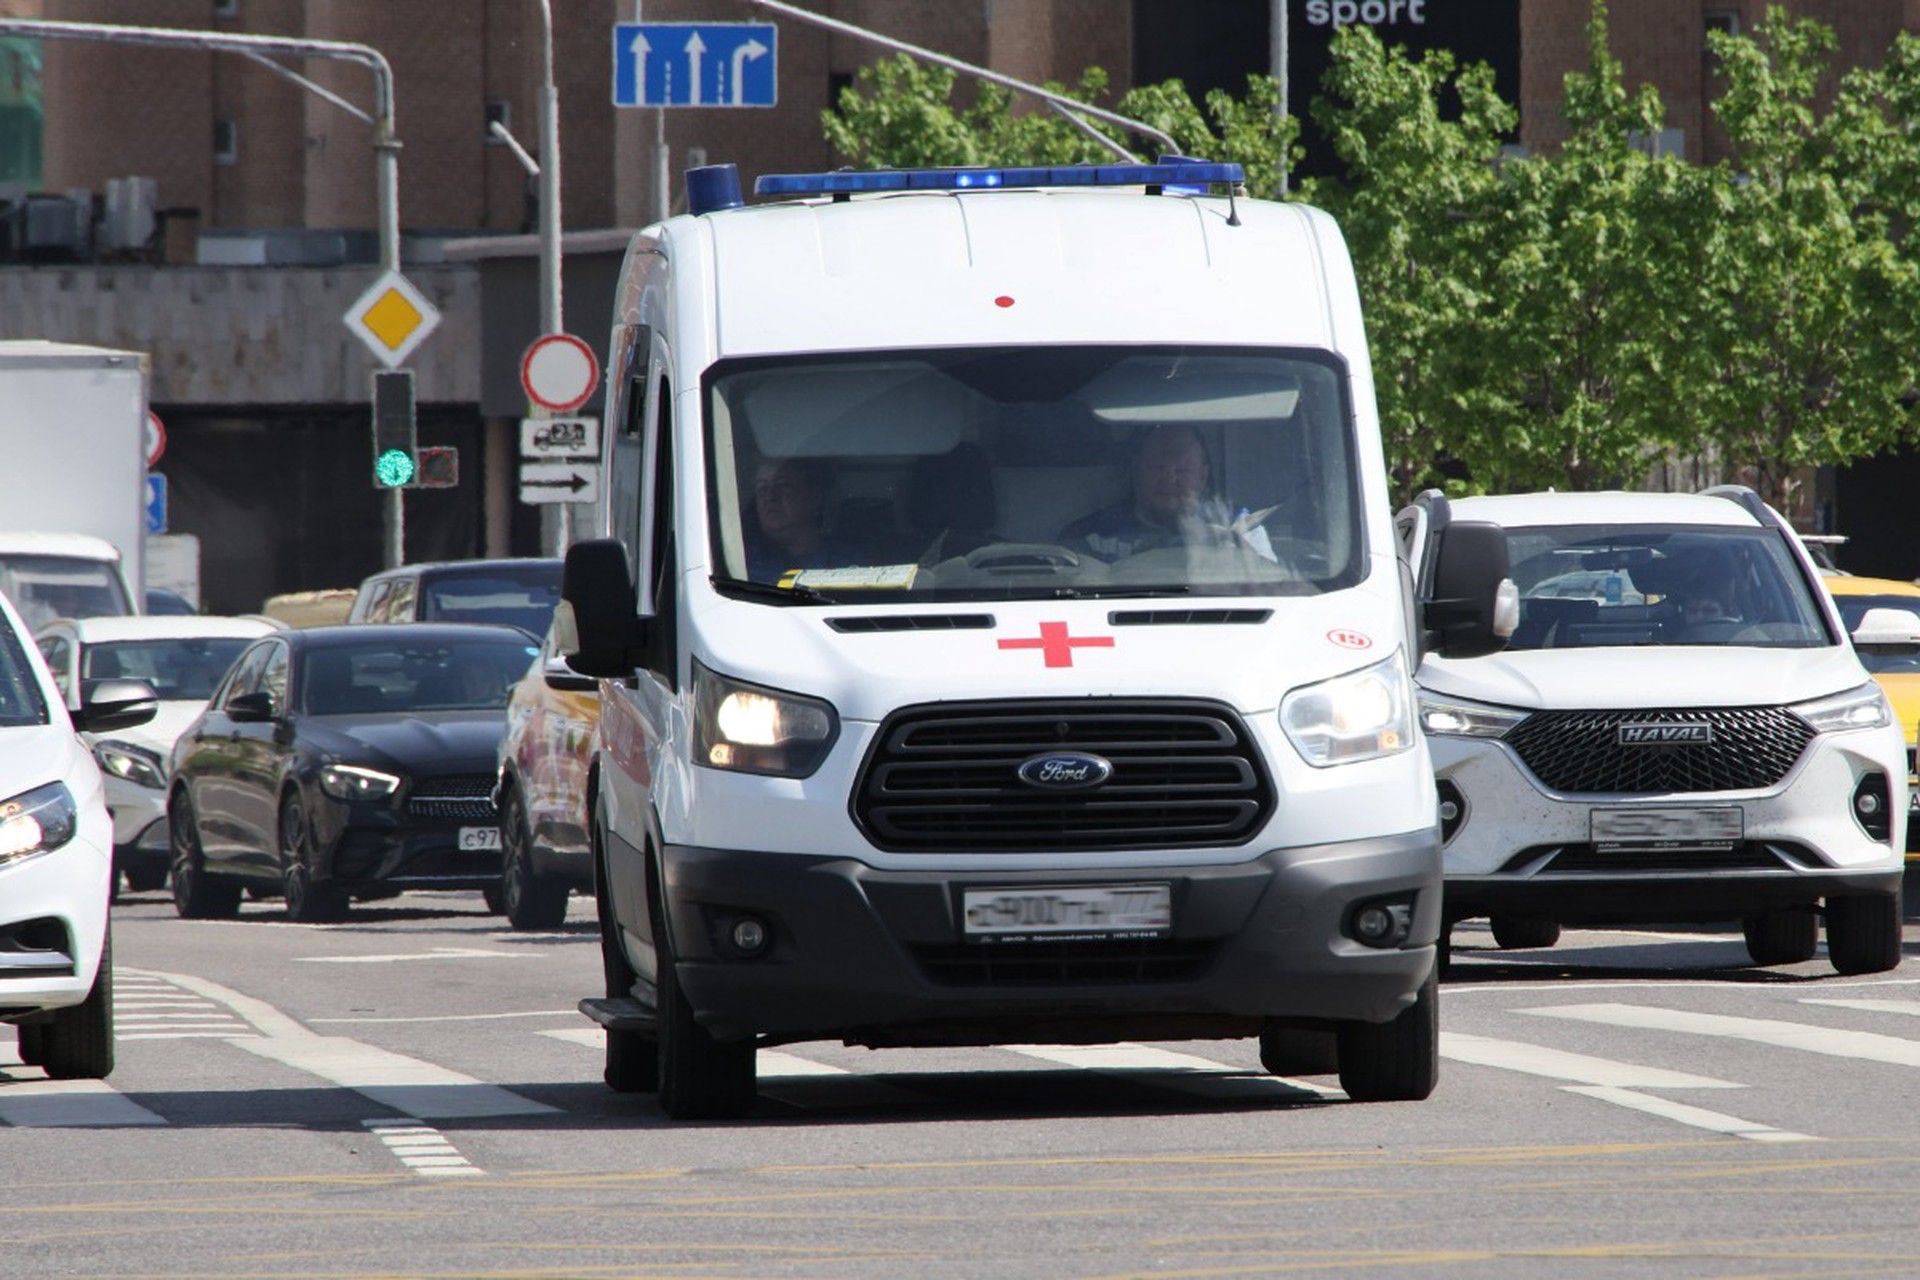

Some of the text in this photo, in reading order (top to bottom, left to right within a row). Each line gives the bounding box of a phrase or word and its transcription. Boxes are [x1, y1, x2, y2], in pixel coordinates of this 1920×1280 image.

[1306, 0, 1425, 29] sport
[1624, 728, 1705, 741] HAVAL
[1040, 760, 1089, 781] Ford
